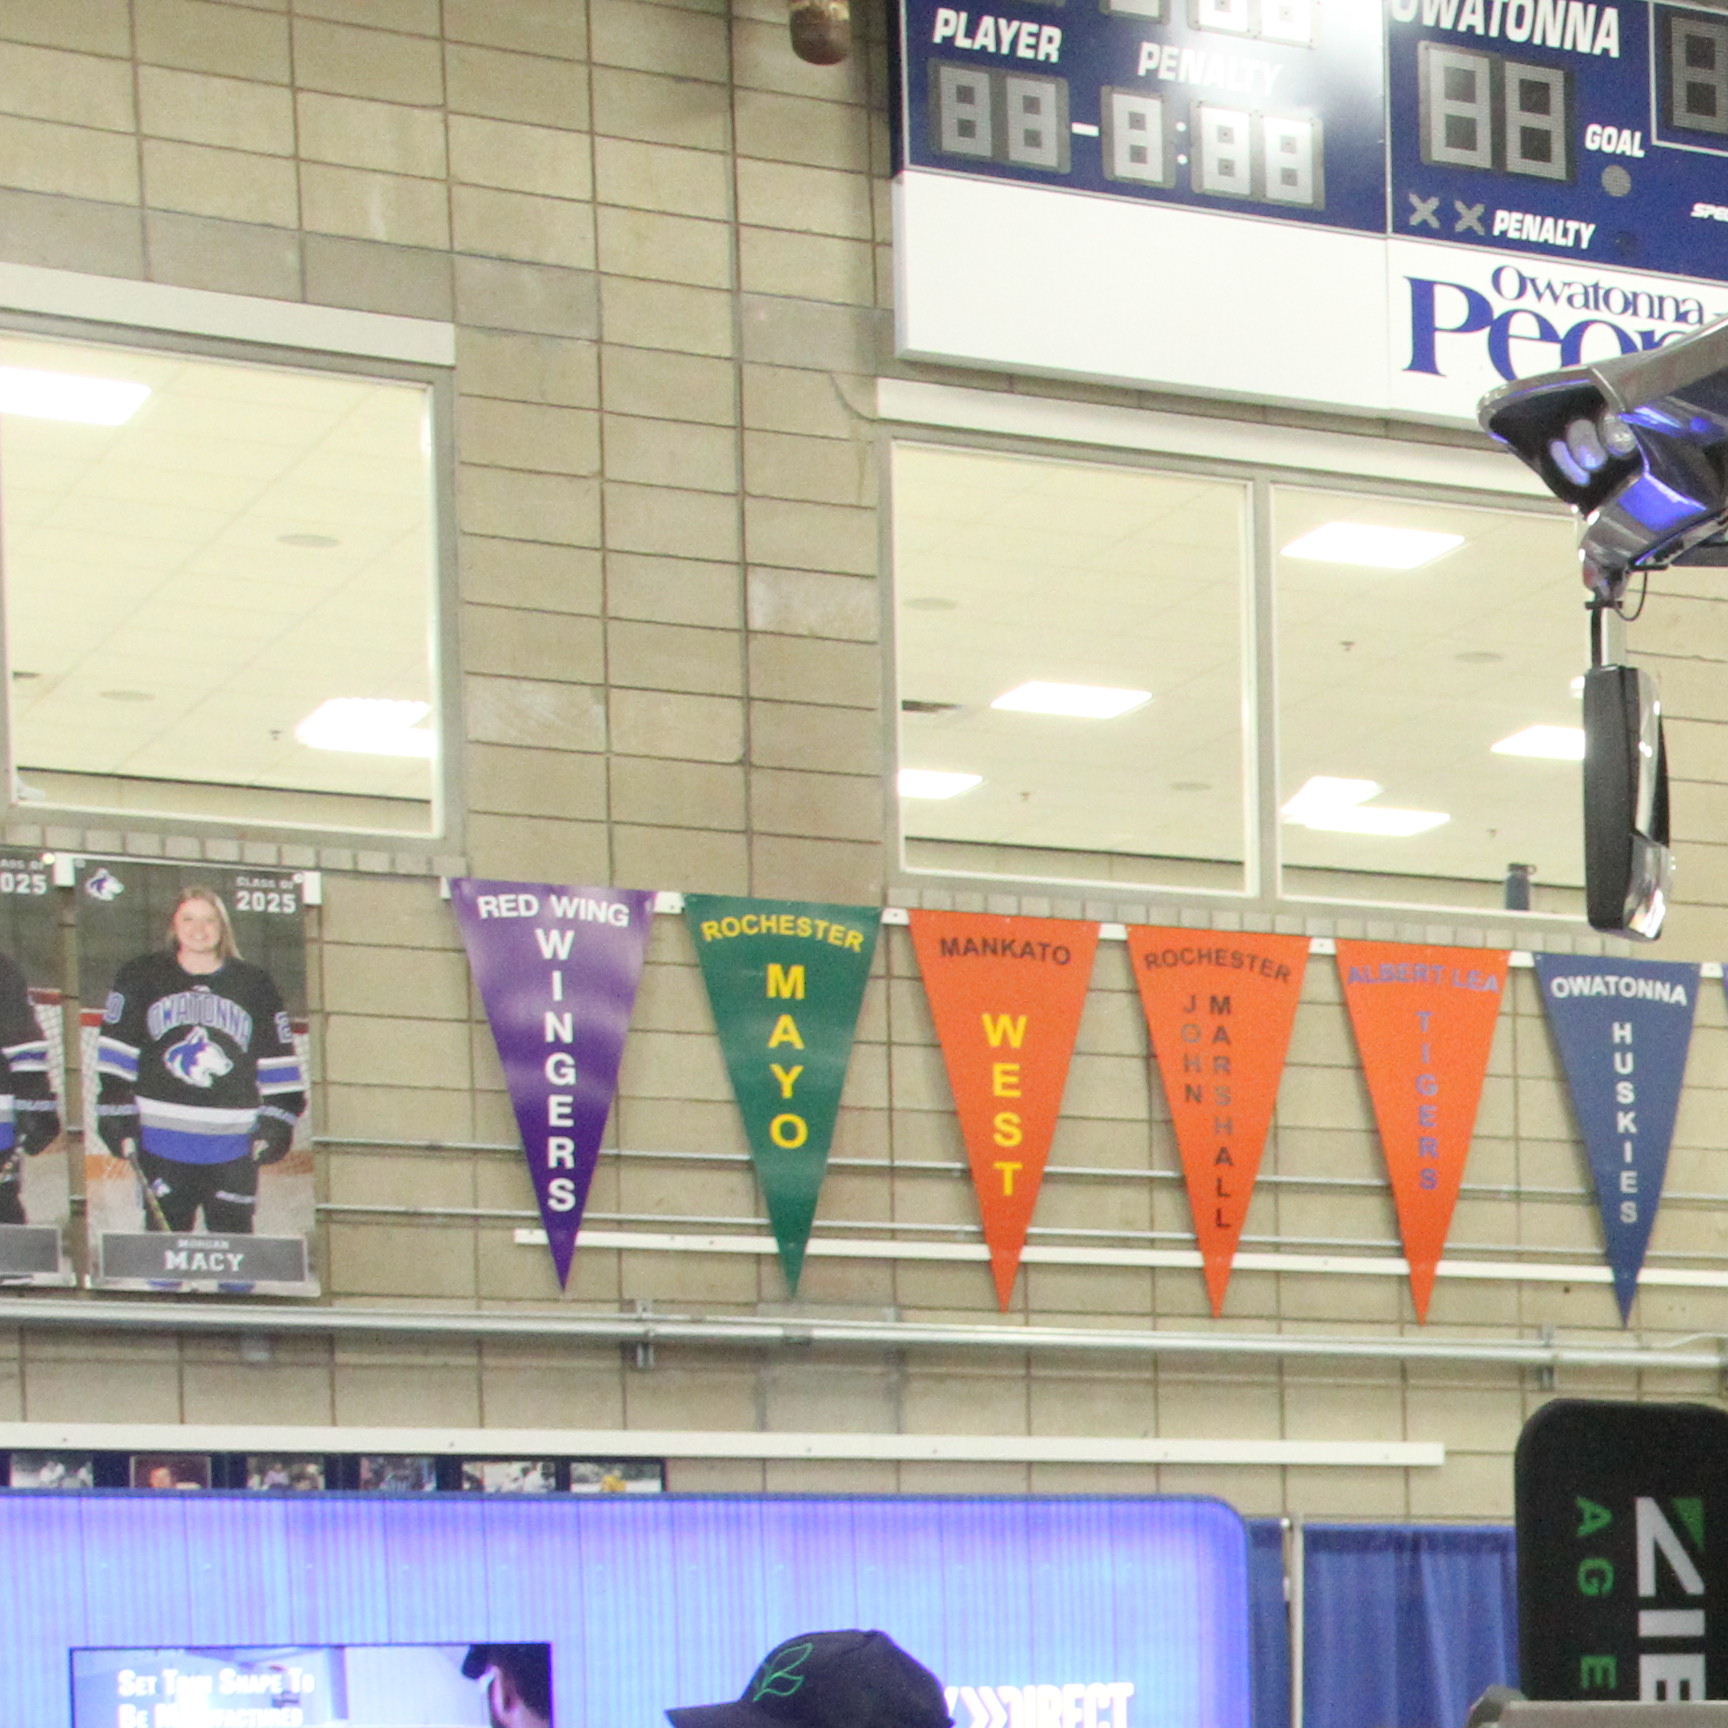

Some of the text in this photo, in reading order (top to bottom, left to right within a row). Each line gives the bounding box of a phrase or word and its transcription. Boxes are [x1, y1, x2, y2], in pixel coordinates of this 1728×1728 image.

[933, 7, 1063, 63] PLAYER
[1138, 41, 1285, 97] PENALTY
[1584, 123, 1645, 158] GOAL
[1492, 209, 1596, 249] PENALTY
[1491, 264, 1706, 327] Owatonna
[0, 873, 47, 895] 025
[235, 890, 297, 913] 2025
[477, 893, 631, 927] RED WING
[701, 913, 865, 953] ROCHESTER
[939, 936, 1072, 967] MANKATO
[1144, 947, 1292, 984] ROCHESTER
[1348, 962, 1500, 994] ALBERT LEA
[1550, 975, 1688, 1007] OWATONNA
[147, 991, 253, 1053] OWATONNA
[535, 928, 577, 1212] WINGERS
[766, 963, 808, 1150] MAYO
[1181, 994, 1203, 1104] JOHN
[982, 1014, 1028, 1196] WEST
[1209, 995, 1234, 1229] MARSHALL
[1415, 1010, 1439, 1191] TIGERS
[1612, 1022, 1638, 1224] HUSKIES
[164, 1250, 244, 1273] MACY
